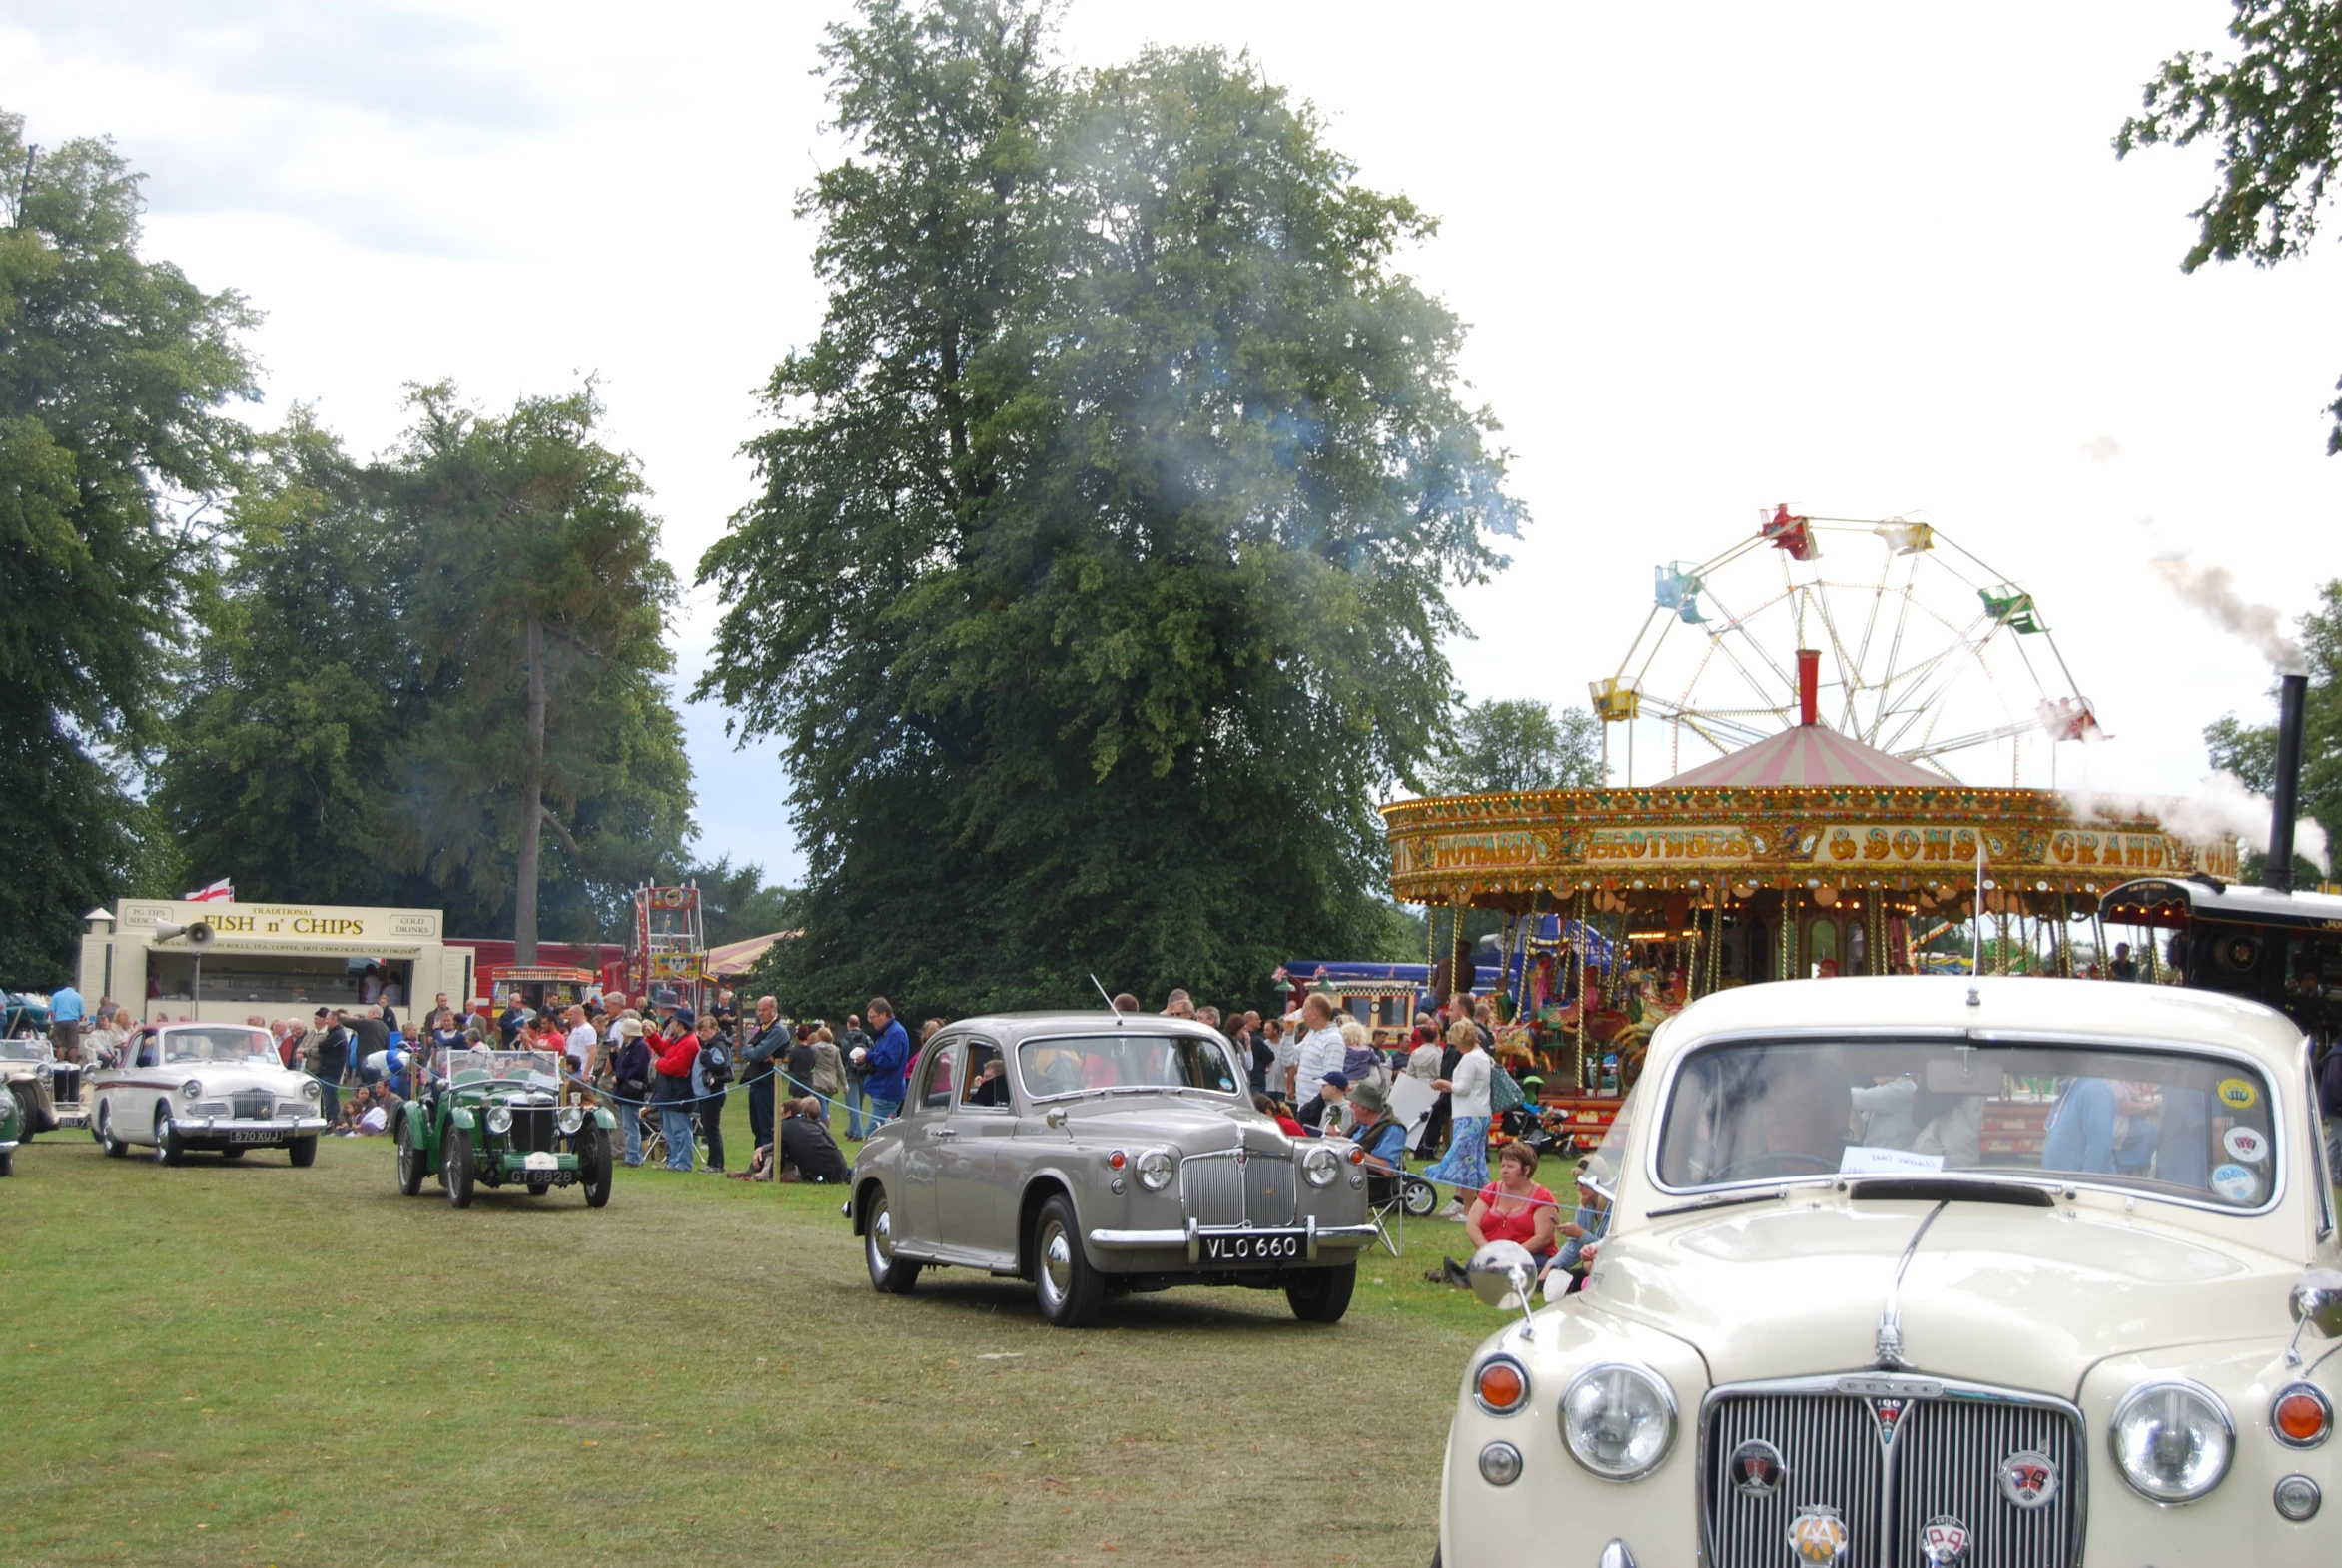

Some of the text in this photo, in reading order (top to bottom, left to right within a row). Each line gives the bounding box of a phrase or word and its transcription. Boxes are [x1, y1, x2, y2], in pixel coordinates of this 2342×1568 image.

[1437, 832, 1534, 868] HOWARD
[1590, 830, 1749, 859] BROTHERS
[1829, 828, 1857, 860] &
[1863, 828, 1977, 861] SONS
[2051, 832, 2163, 868] GRAND
[252, 907, 314, 916] TRADITIONAL
[203, 915, 255, 932] FISH
[293, 917, 364, 936] CHIPS
[235, 1130, 278, 1141] 570 XUJ
[511, 1170, 572, 1182] GT 6828
[1206, 1237, 1297, 1258] VLO 660
[1801, 1518, 1835, 1546] AA
